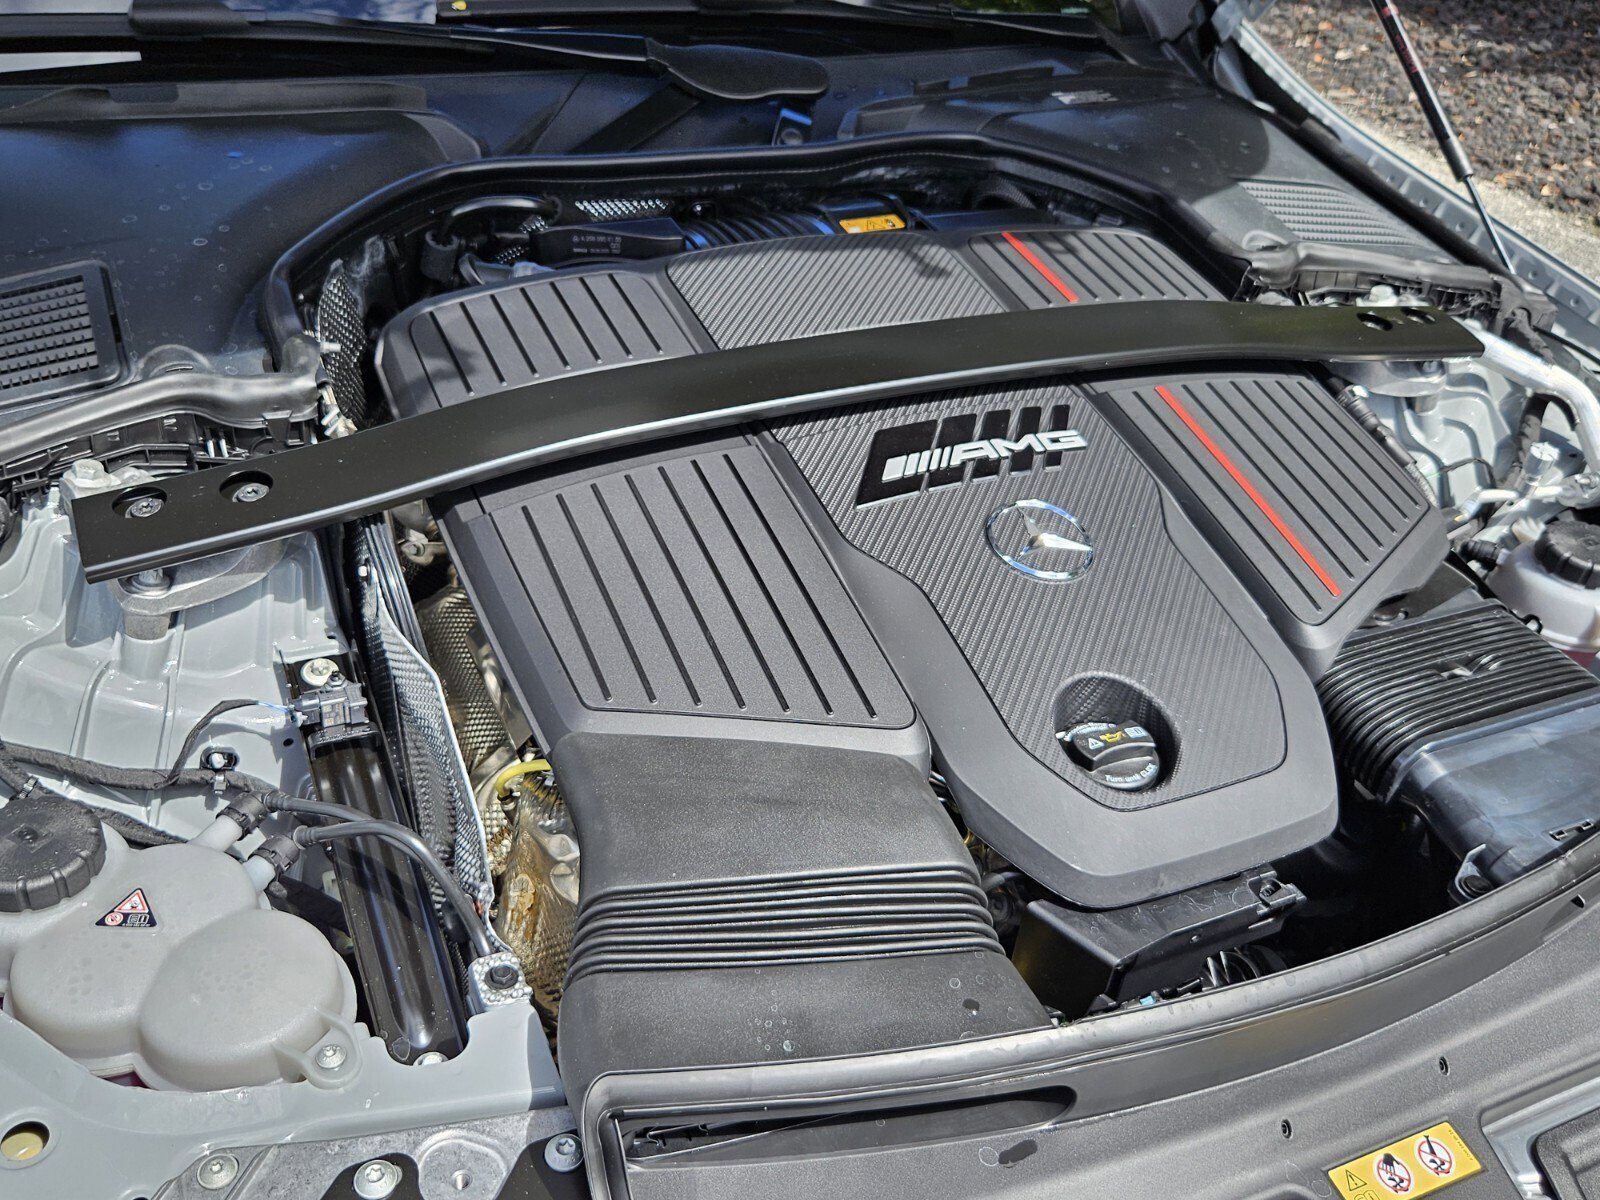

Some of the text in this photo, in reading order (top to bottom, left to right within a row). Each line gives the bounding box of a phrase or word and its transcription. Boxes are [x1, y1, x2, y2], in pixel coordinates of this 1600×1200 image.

[949, 430, 1088, 468] AMG
[1105, 774, 1123, 782] Turn
[1125, 773, 1141, 782] until
